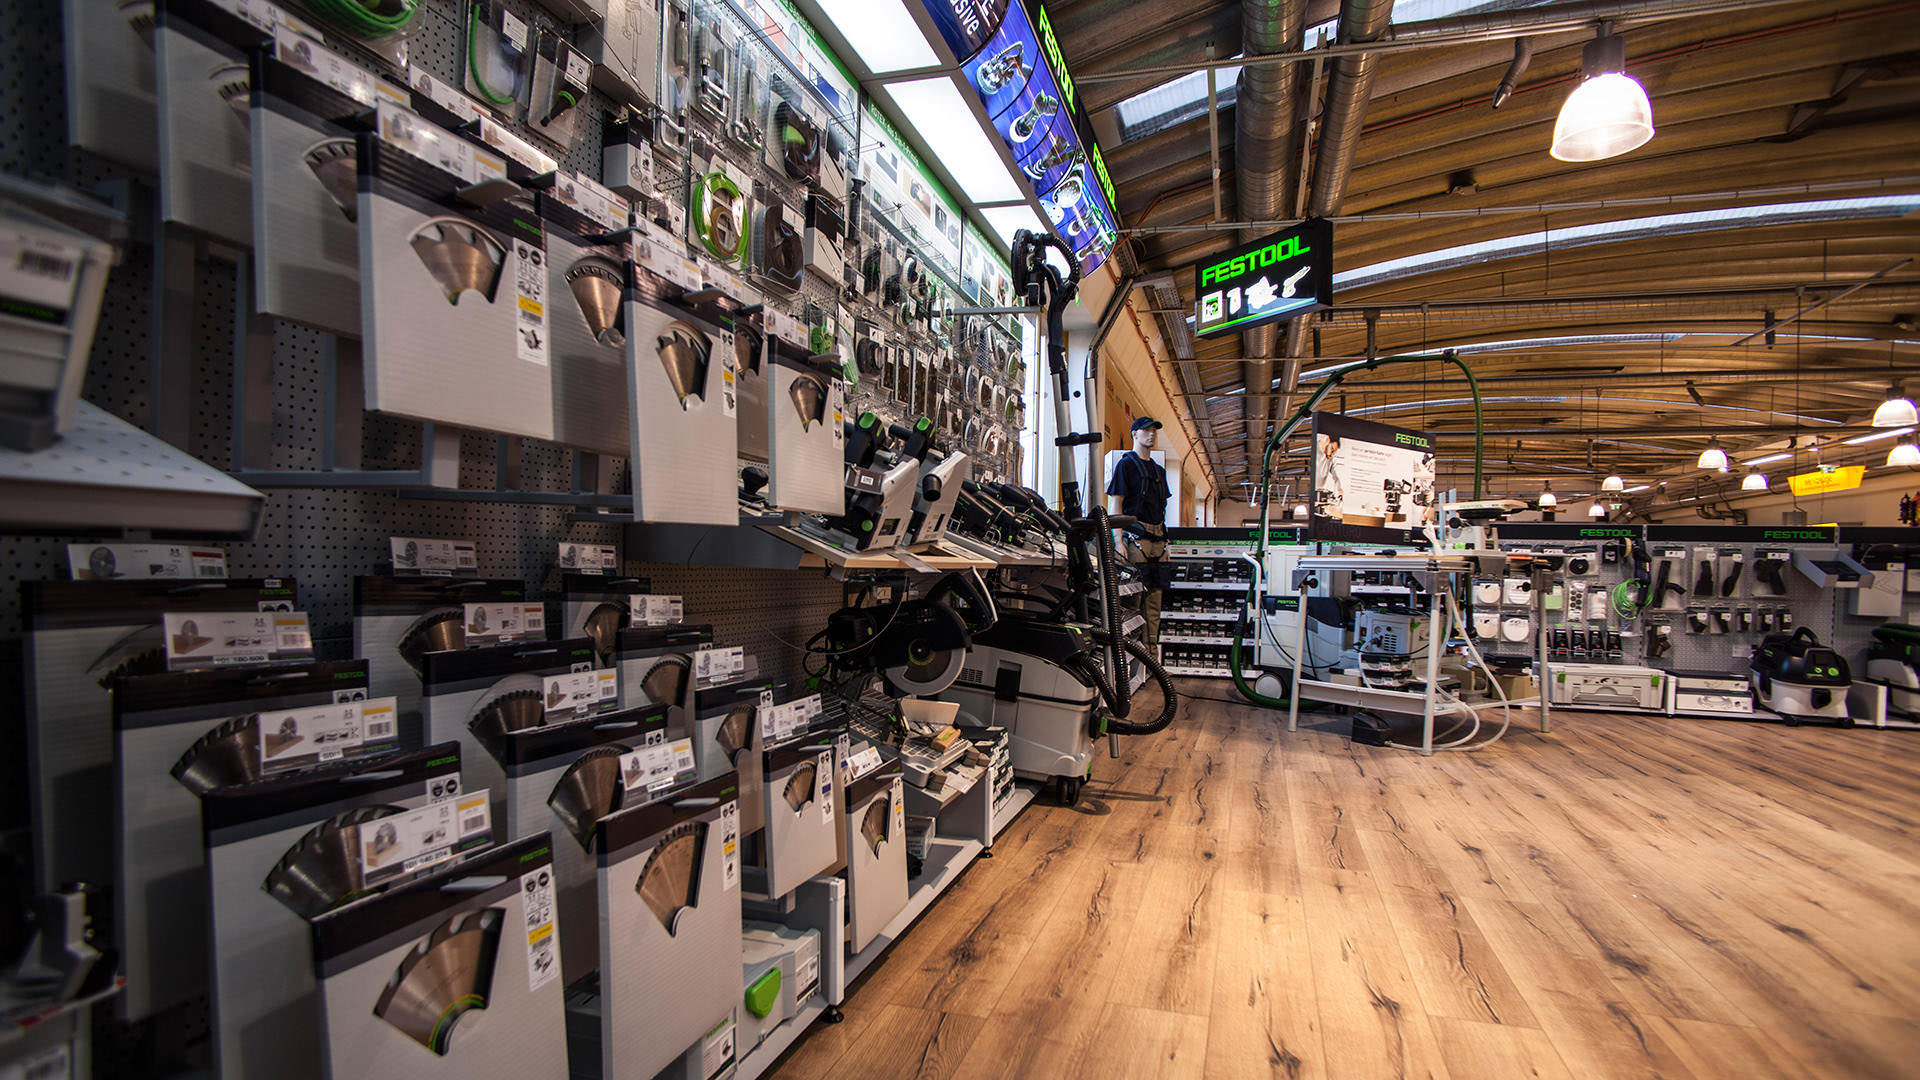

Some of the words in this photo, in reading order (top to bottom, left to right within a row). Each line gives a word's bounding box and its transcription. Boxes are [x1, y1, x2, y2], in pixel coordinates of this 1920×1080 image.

[1039, 5, 1076, 115] FESTOOL
[1093, 142, 1117, 213] FESTOOL
[1201, 235, 1311, 288] FESTOOL
[1395, 433, 1430, 448] FESTOOL
[1579, 528, 1637, 537] FESTOOL
[1764, 530, 1827, 539] FESTOOL
